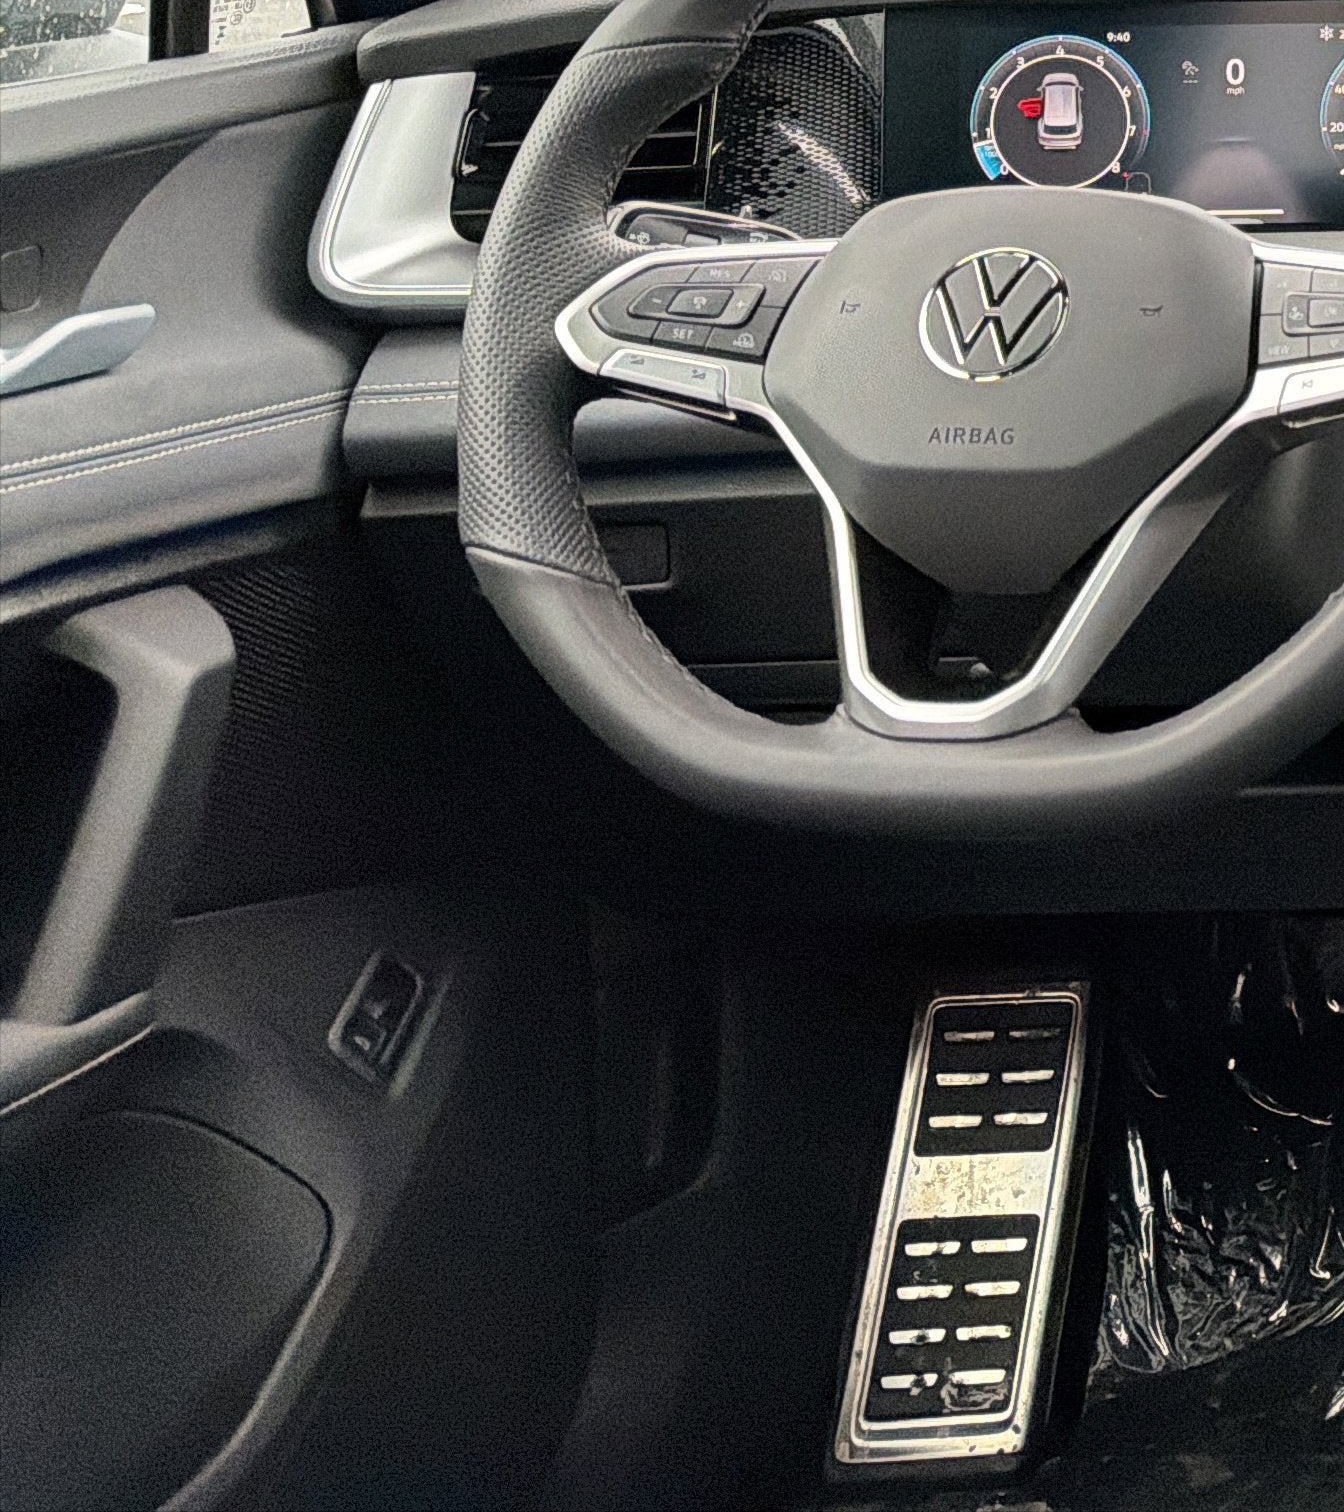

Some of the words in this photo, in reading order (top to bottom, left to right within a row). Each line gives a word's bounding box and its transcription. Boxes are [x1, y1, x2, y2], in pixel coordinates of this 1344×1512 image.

[1106, 31, 1131, 42] 9:40
[1055, 45, 1064, 55] 4
[1016, 57, 1025, 68] 3
[1096, 56, 1105, 67] 5
[1225, 58, 1246, 86] 0
[988, 88, 998, 99] 2
[1123, 86, 1132, 97] 6
[1226, 87, 1246, 96] mph
[1129, 125, 1136, 136] 7
[1330, 122, 1344, 132] 20
[985, 128, 991, 138] 1
[1111, 162, 1120, 174] 8
[672, 328, 693, 339] SET
[928, 426, 1015, 445] AIRBAG
